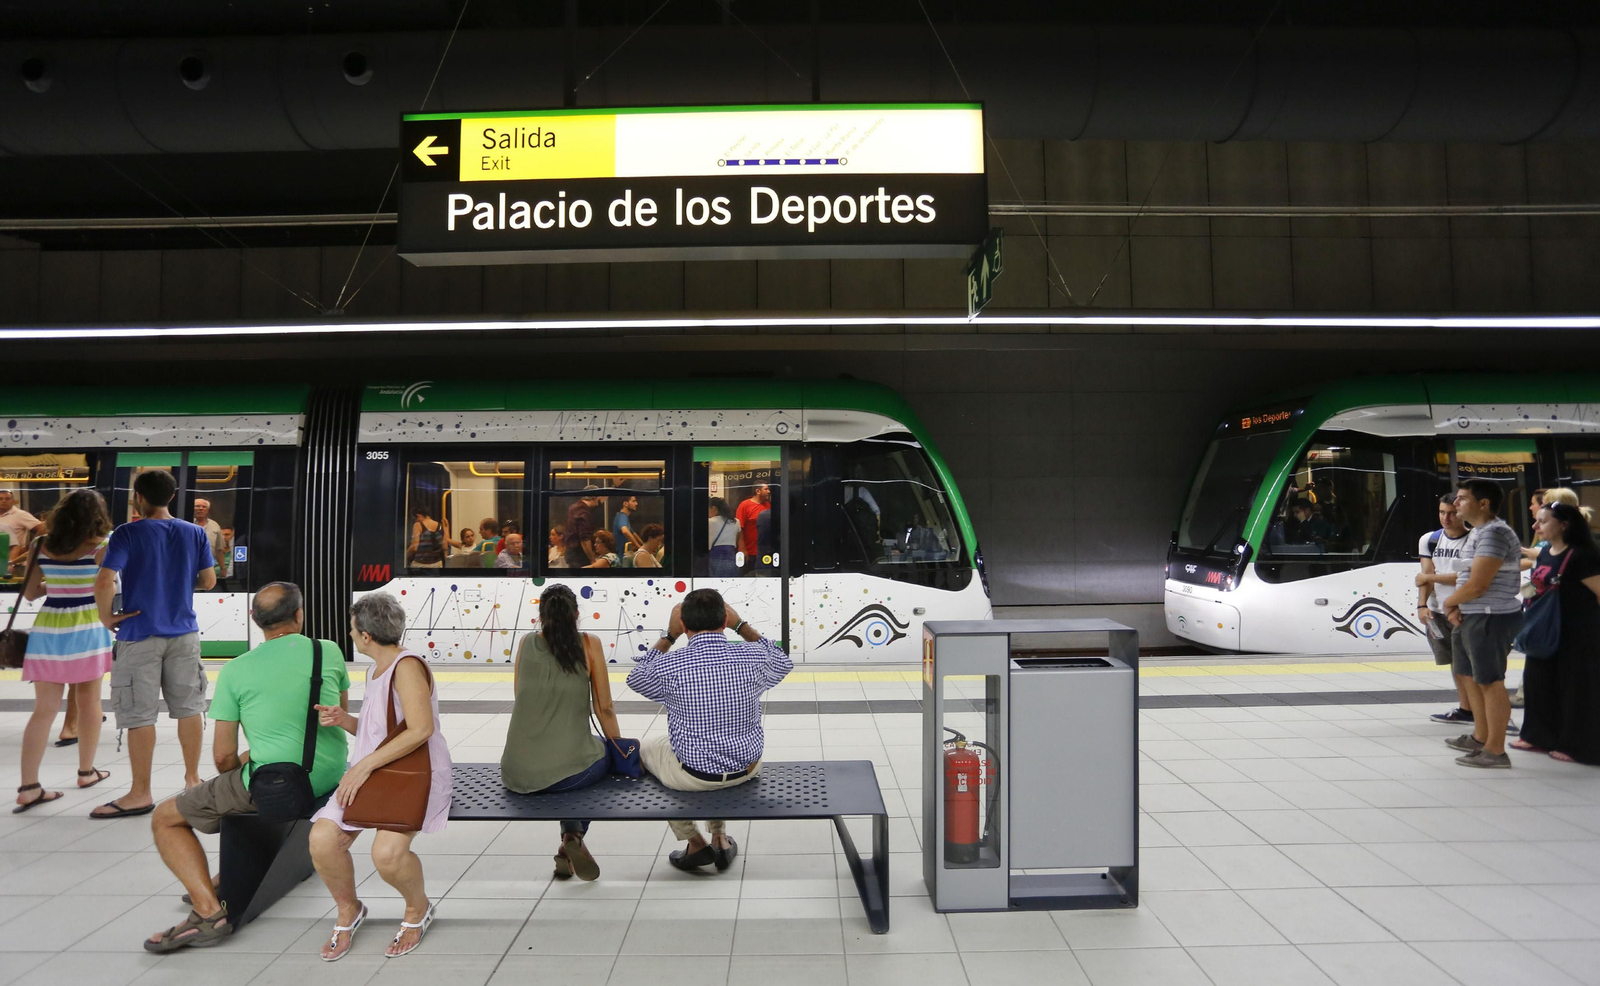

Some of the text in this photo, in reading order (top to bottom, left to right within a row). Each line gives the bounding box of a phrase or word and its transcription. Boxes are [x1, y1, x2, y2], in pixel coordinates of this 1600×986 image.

[482, 126, 556, 150] Salida
[481, 155, 511, 171] Exit
[447, 186, 937, 233] Palacio de los Deportes
[366, 451, 389, 460] 3055
